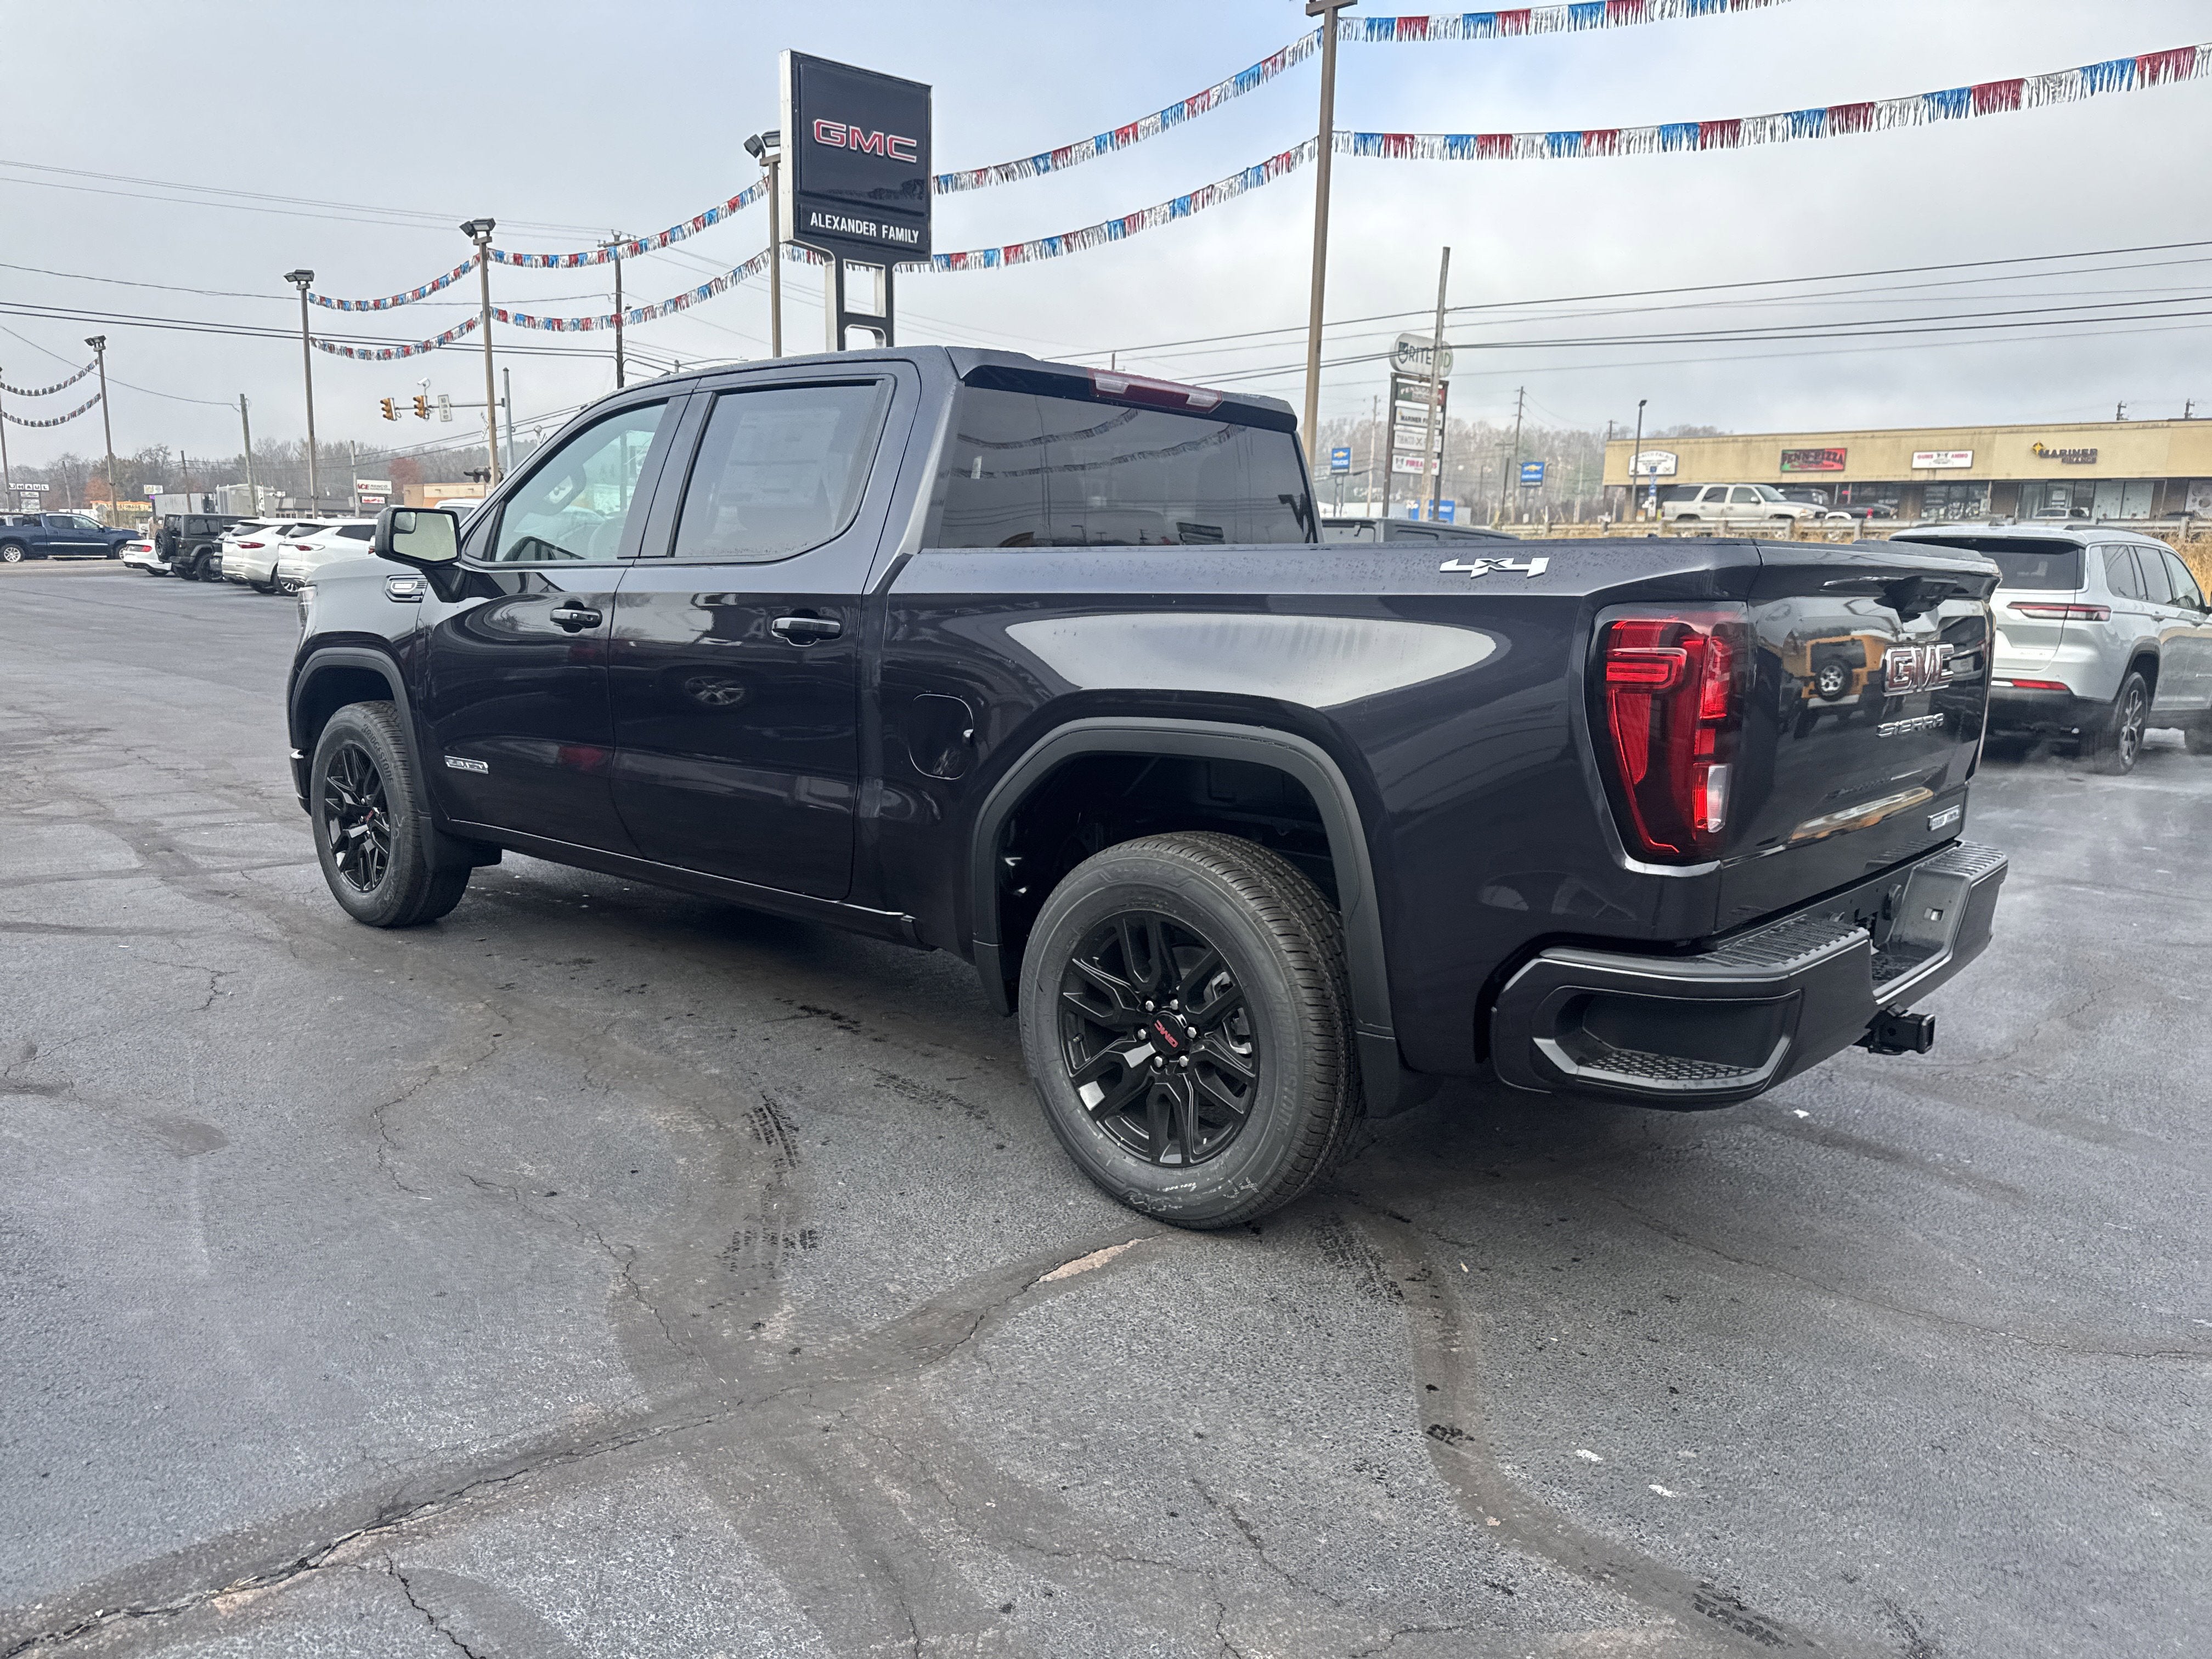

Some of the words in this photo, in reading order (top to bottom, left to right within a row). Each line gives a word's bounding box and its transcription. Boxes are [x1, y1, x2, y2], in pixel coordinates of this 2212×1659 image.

[814, 119, 917, 163] GMC
[810, 212, 877, 237] ALEXANDER
[882, 225, 919, 244] FAMILY
[1409, 345, 1432, 365] RITE
[2039, 448, 2098, 459] MARINER
[2062, 456, 2097, 464] FINANCE
[1883, 643, 1955, 697] GMC
[1876, 713, 1945, 738] SIERRA
[1154, 1019, 1178, 1048] GMC
